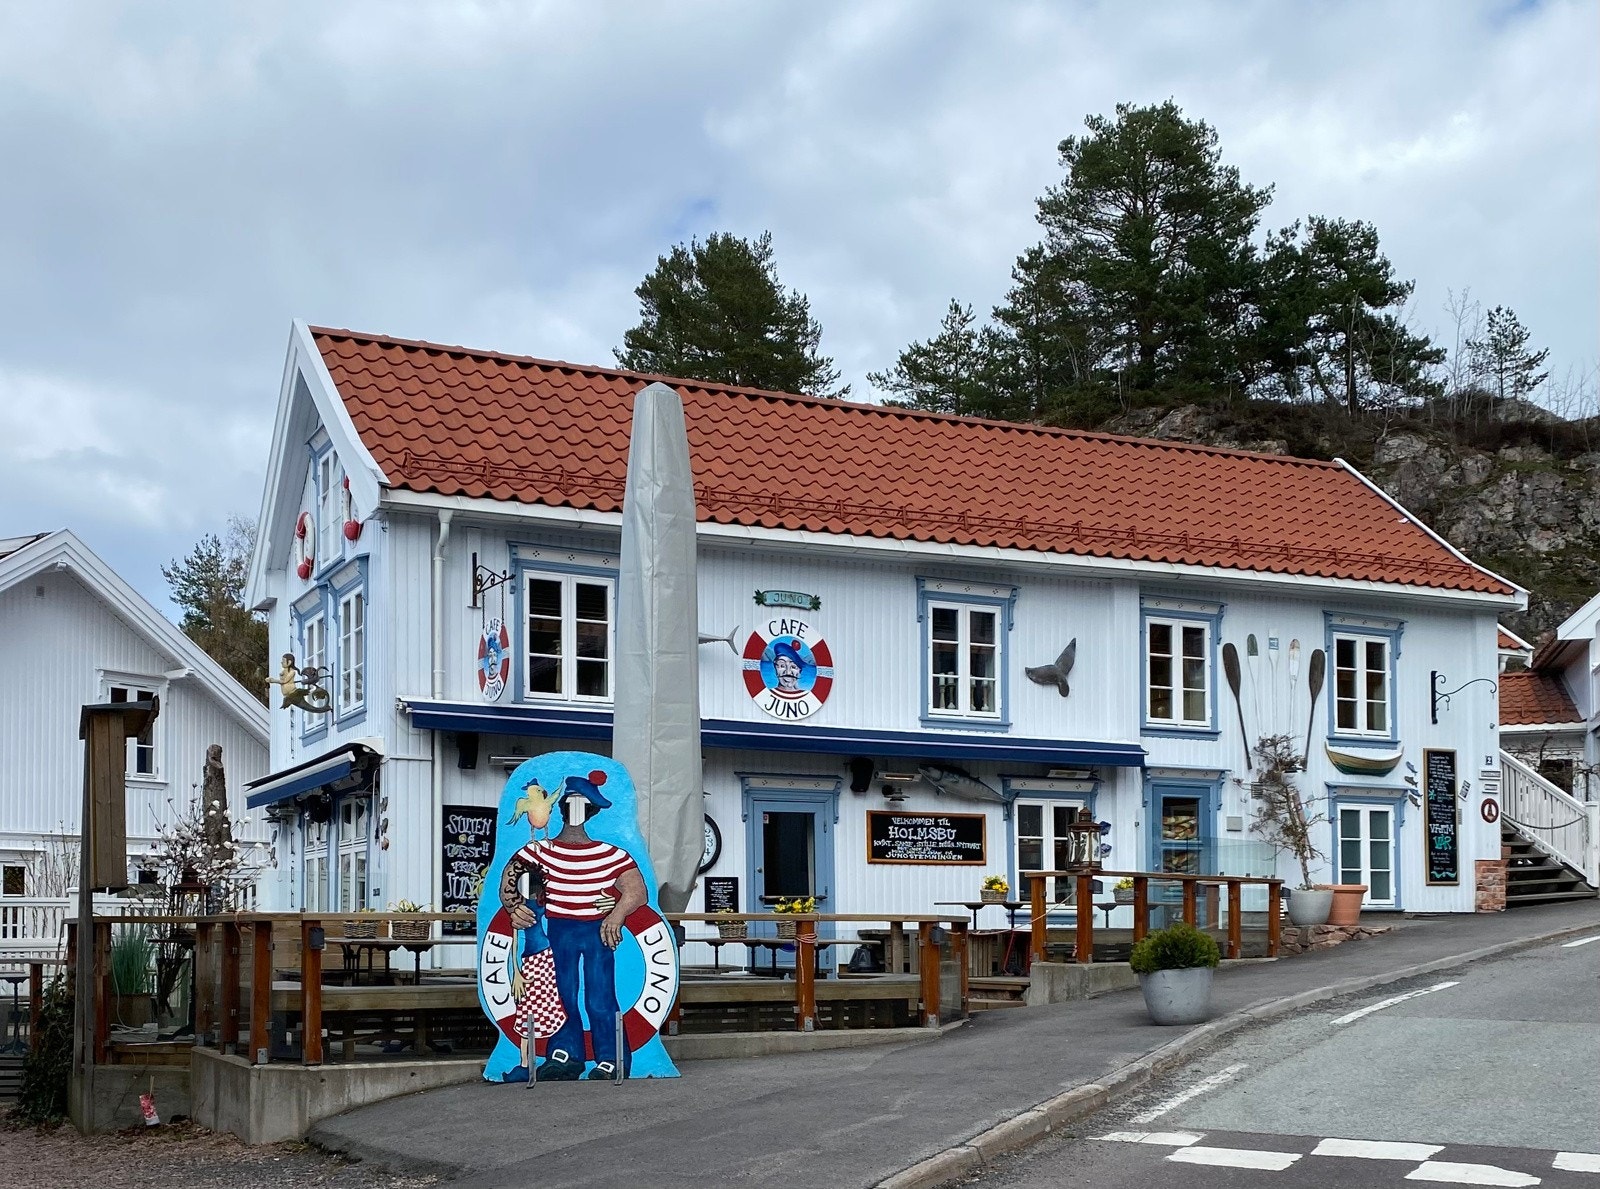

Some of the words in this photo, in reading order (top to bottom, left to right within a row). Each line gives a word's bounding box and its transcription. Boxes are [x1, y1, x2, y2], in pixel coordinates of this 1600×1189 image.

[773, 592, 803, 605] JUNO
[485, 618, 501, 636] CAFE
[768, 618, 809, 640] CAFE
[485, 679, 502, 698] JUNO
[764, 694, 810, 718] JUNO
[891, 816, 935, 826] VELKOMMEN
[937, 817, 951, 826] TIL
[888, 825, 957, 840] HOLMSBU
[444, 872, 485, 899] JUN
[643, 929, 670, 1014] JUNO
